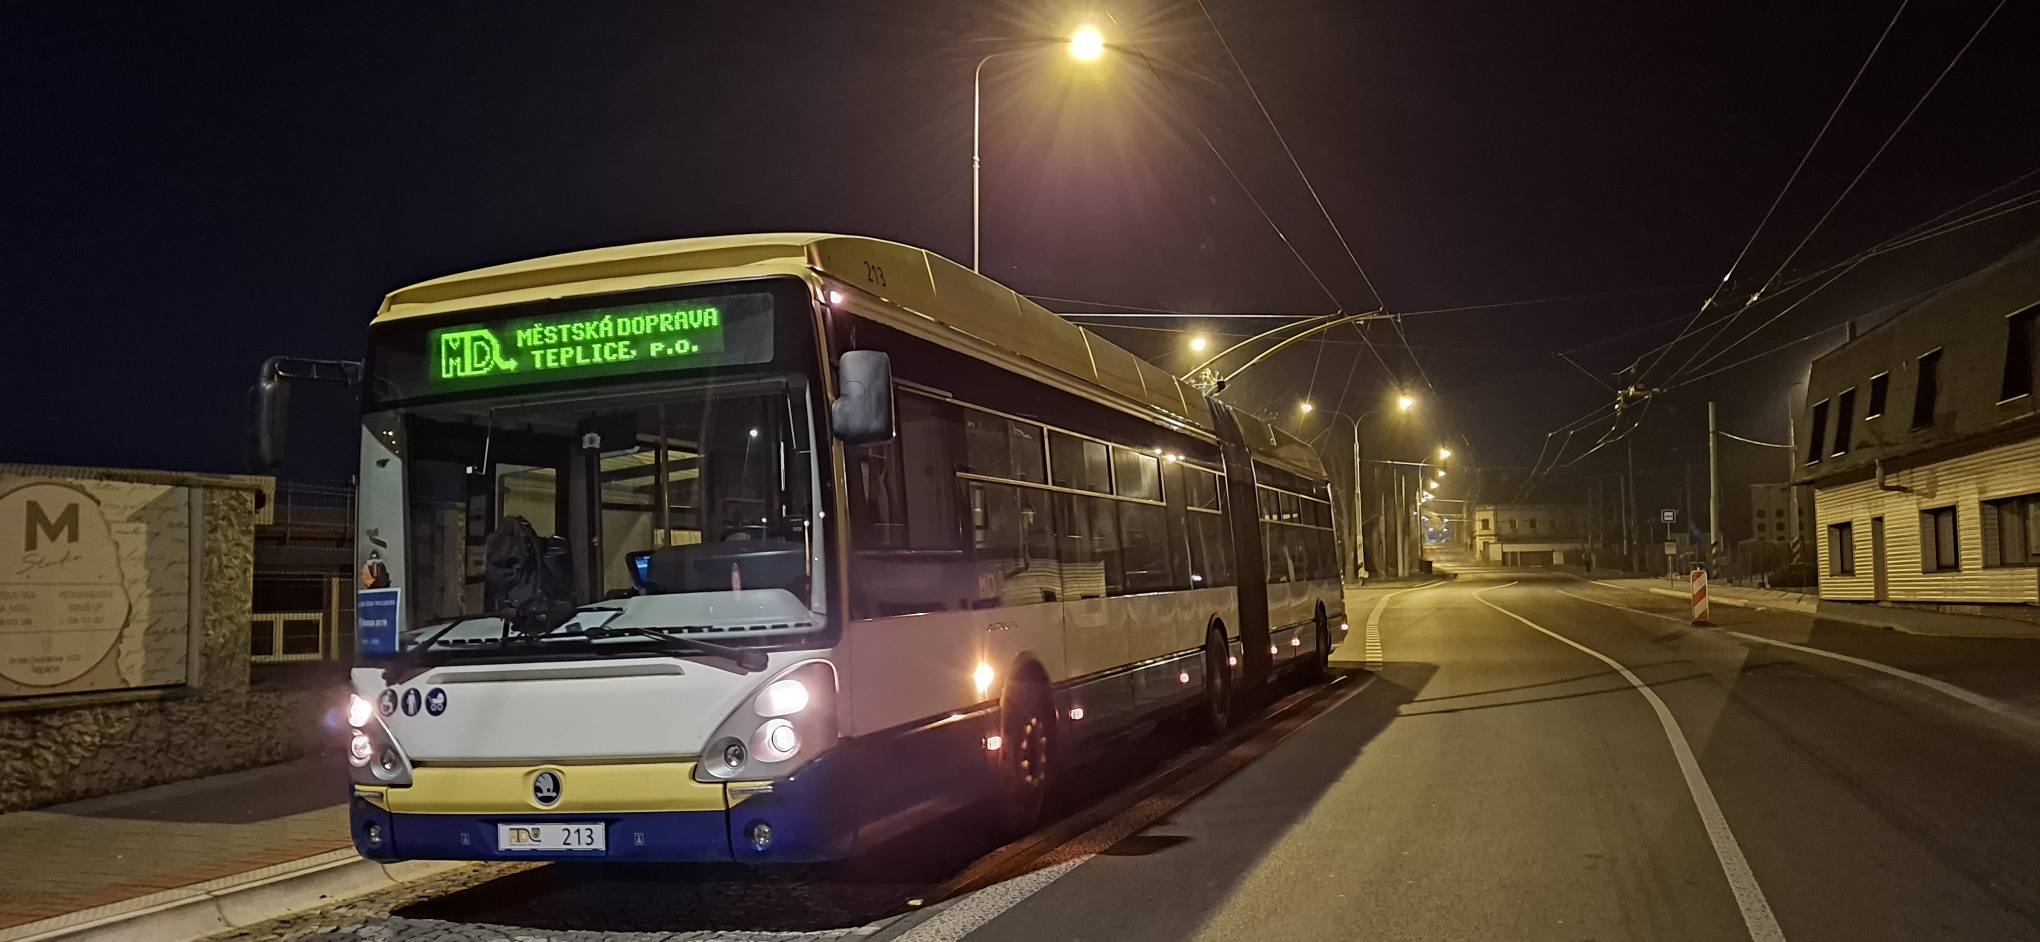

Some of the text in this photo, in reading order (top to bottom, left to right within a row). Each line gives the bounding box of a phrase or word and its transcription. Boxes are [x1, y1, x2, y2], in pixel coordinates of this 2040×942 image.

[863, 260, 887, 287] 213
[516, 308, 718, 347] MĚSTSKÁ DOPRAVA
[531, 341, 636, 369] TEPLICE,
[24, 500, 79, 552] M
[562, 827, 594, 846] 213
